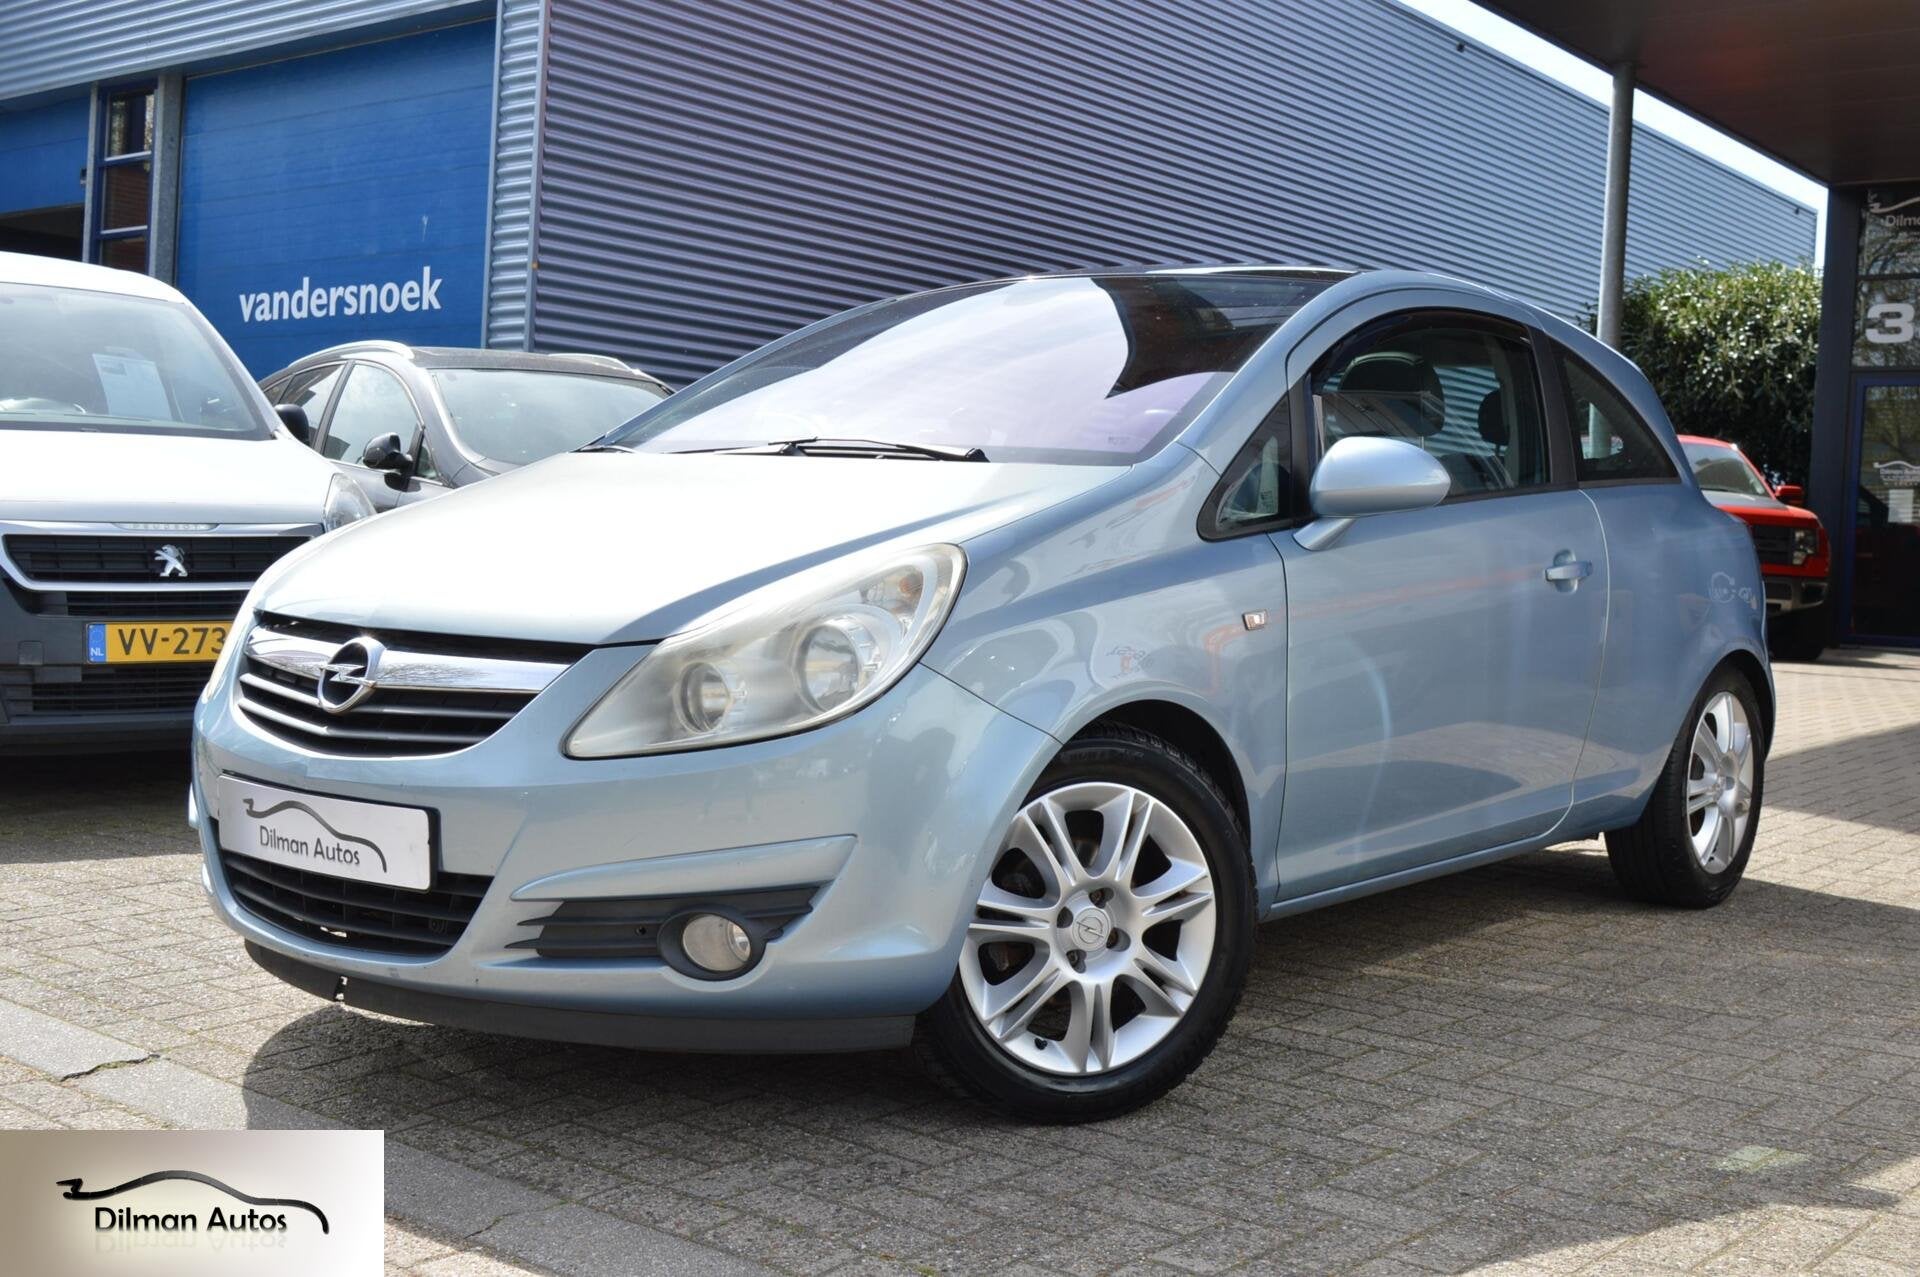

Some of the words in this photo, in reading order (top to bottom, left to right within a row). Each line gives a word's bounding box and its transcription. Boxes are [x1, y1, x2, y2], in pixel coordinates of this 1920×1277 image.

[239, 265, 443, 322] vandersnoek
[1865, 303, 1915, 343] 3
[90, 647, 104, 657] NL
[259, 825, 309, 857] Dilman
[313, 837, 361, 866] Autos
